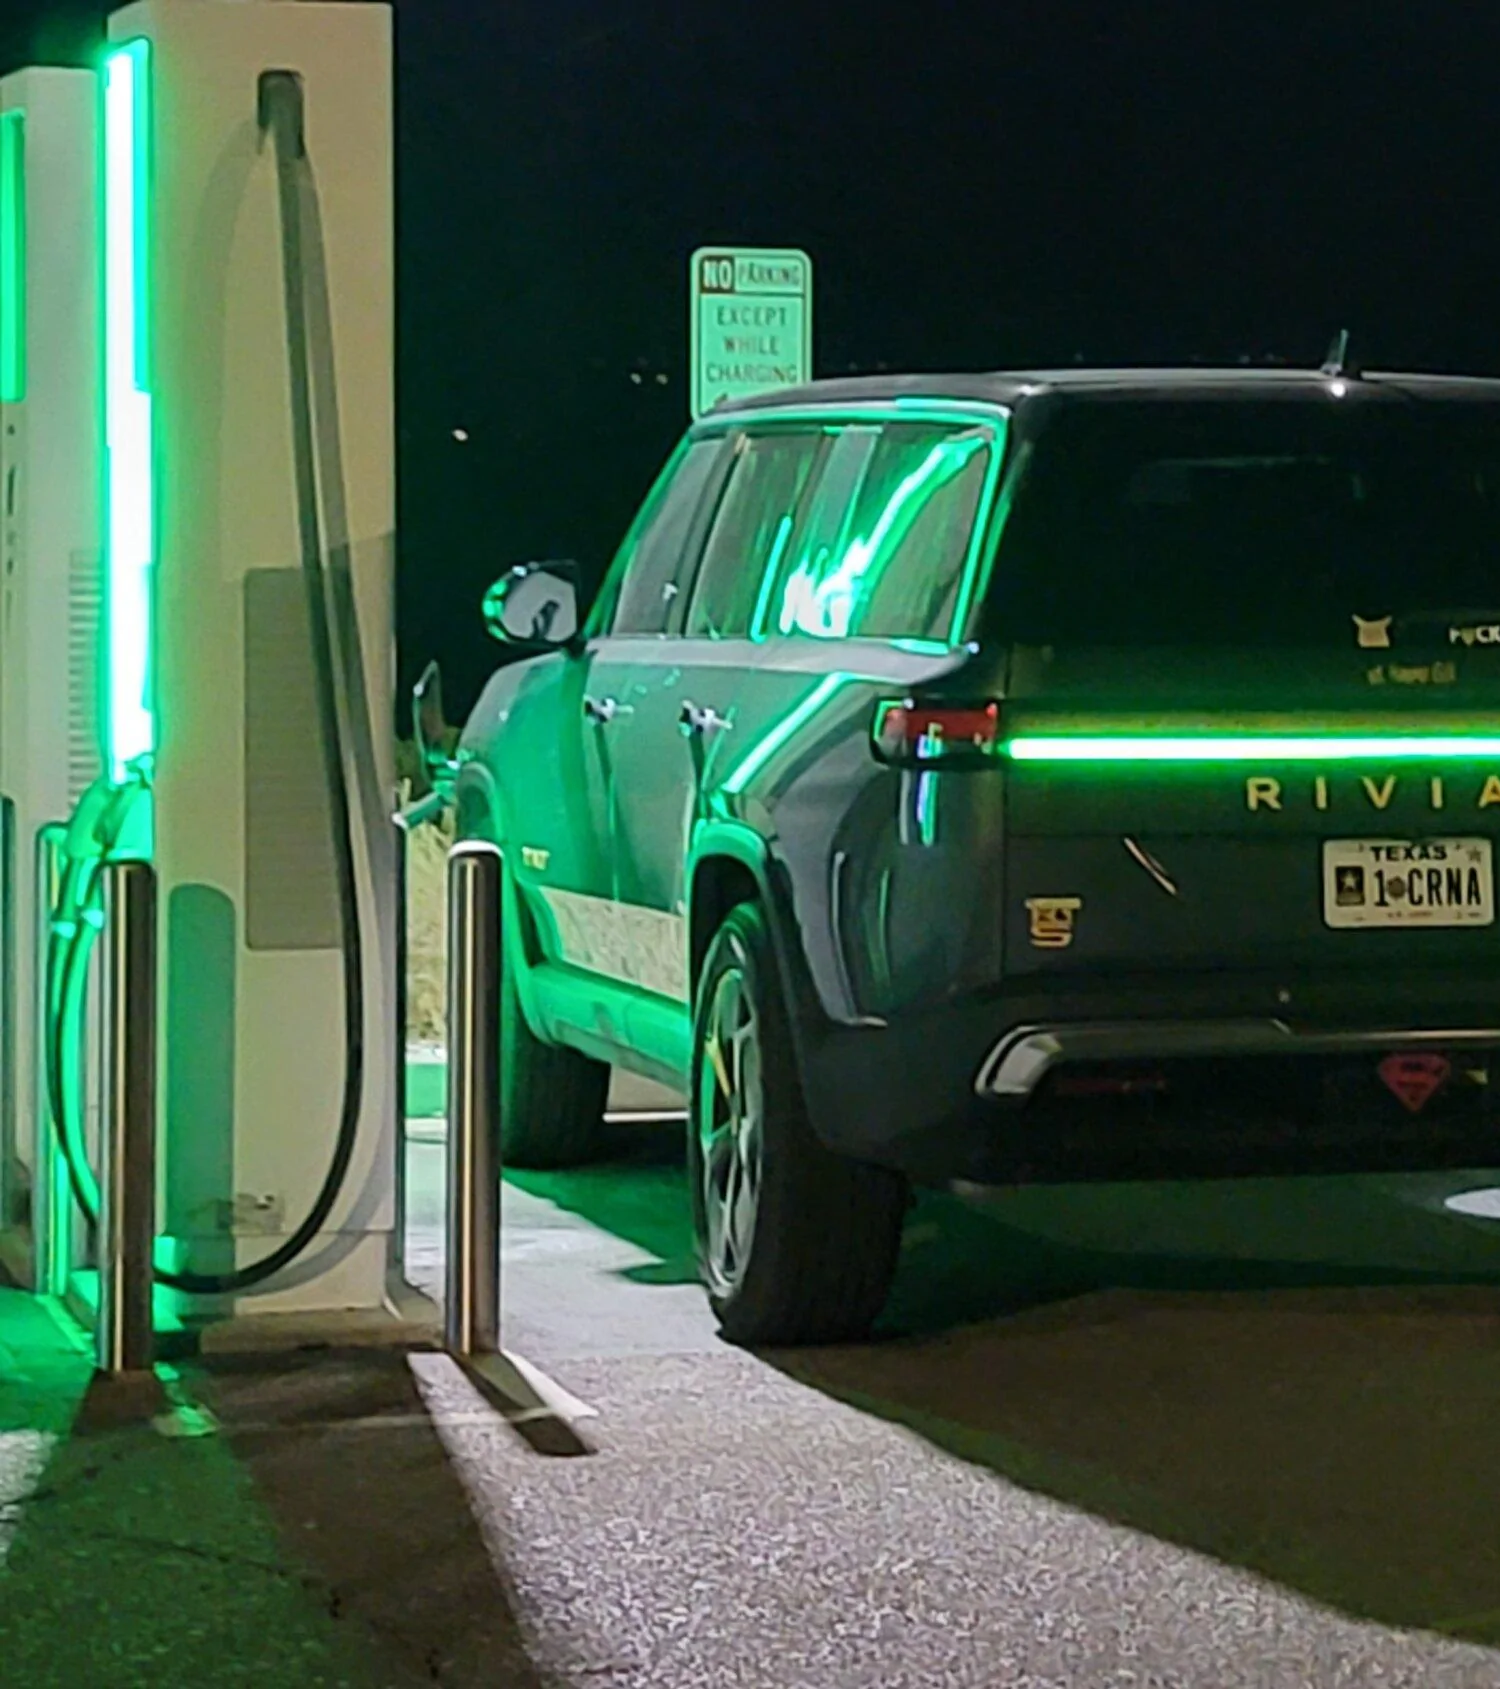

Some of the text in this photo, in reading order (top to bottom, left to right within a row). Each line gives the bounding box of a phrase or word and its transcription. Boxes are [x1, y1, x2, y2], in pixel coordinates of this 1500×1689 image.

[703, 259, 732, 289] NO
[716, 306, 787, 326] EXCEPT
[724, 335, 779, 355] WHILE
[706, 361, 798, 384] CHARGING
[1369, 844, 1448, 862] TEXAS
